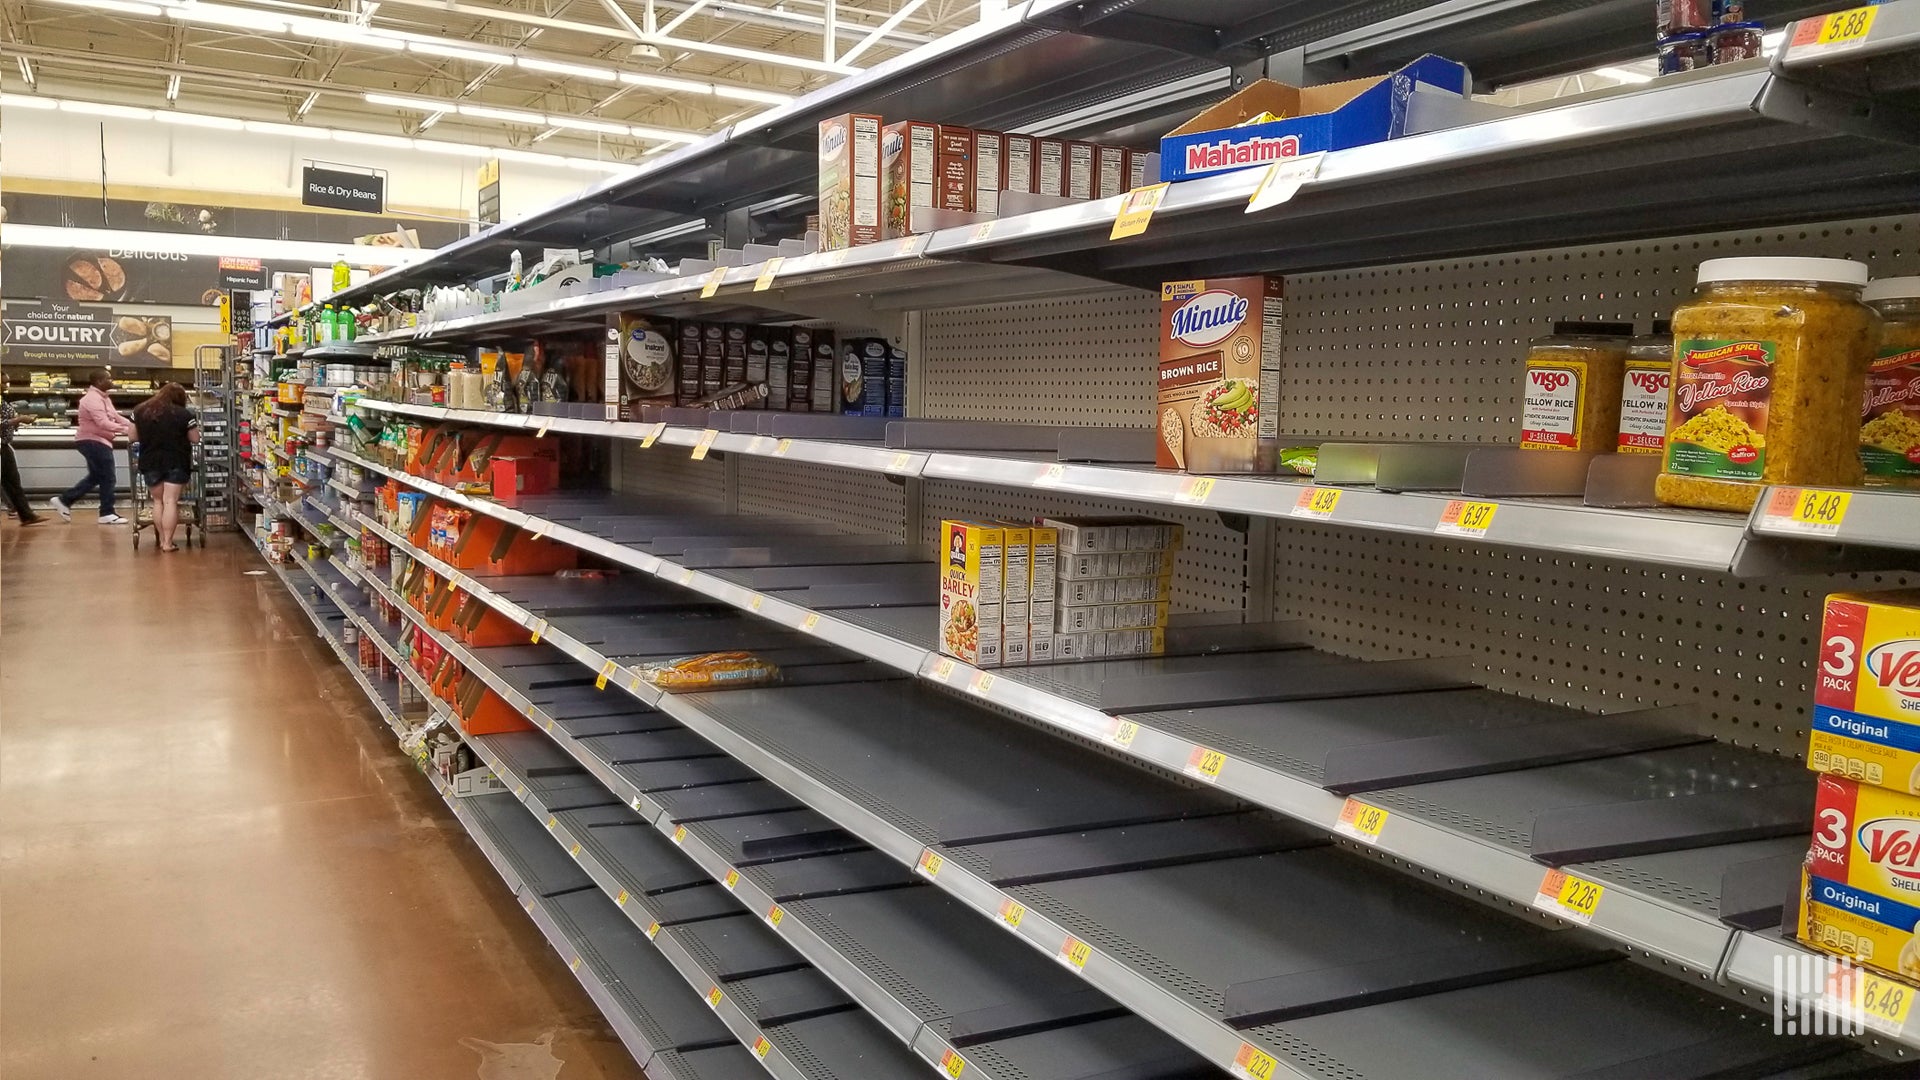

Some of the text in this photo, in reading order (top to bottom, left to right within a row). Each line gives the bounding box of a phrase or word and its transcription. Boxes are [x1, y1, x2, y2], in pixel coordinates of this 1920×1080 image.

[1189, 137, 1297, 170] Mahatma
[310, 183, 377, 200] Rice & Dry Beans
[27, 311, 94, 321] choice for natural
[51, 304, 70, 312] Your
[1172, 297, 1248, 338] Minute
[15, 325, 105, 343] POULTRY
[23, 350, 47, 358] Brought
[67, 352, 75, 360] by
[644, 343, 665, 352] Instant
[1237, 344, 1249, 355] 10
[1692, 343, 1758, 359] AMERICAN SPICE
[1872, 354, 1908, 367] MERICAN
[1161, 361, 1218, 380] BROWN RICE
[1699, 371, 1726, 380] Amarillo
[1678, 370, 1769, 413] Yellow Rice
[1555, 400, 1574, 408] RICE
[1622, 400, 1668, 410] YELLOW RI
[1724, 400, 1748, 408] Spanish
[1529, 432, 1557, 441] U-SELECT
[1629, 436, 1660, 445] U-SELECT
[1731, 451, 1756, 459] Saffron
[950, 569, 966, 581] QUICK
[942, 576, 975, 598] BARLEY
[1822, 635, 1855, 677] 3
[1879, 650, 1920, 687] Ve
[1823, 676, 1852, 692] PACK
[1900, 699, 1920, 710] SHE
[1829, 715, 1889, 739] Original
[1814, 751, 1829, 762] 380
[1846, 740, 1865, 750] CREAMY
[1865, 744, 1883, 755] CHEESE
[1883, 748, 1898, 759] SAUCE
[1816, 808, 1847, 849] 3
[1870, 829, 1920, 867] Vel
[1816, 848, 1845, 865] PACK
[1823, 886, 1880, 915] Original
[1249, 1055, 1270, 1079] 2.22
